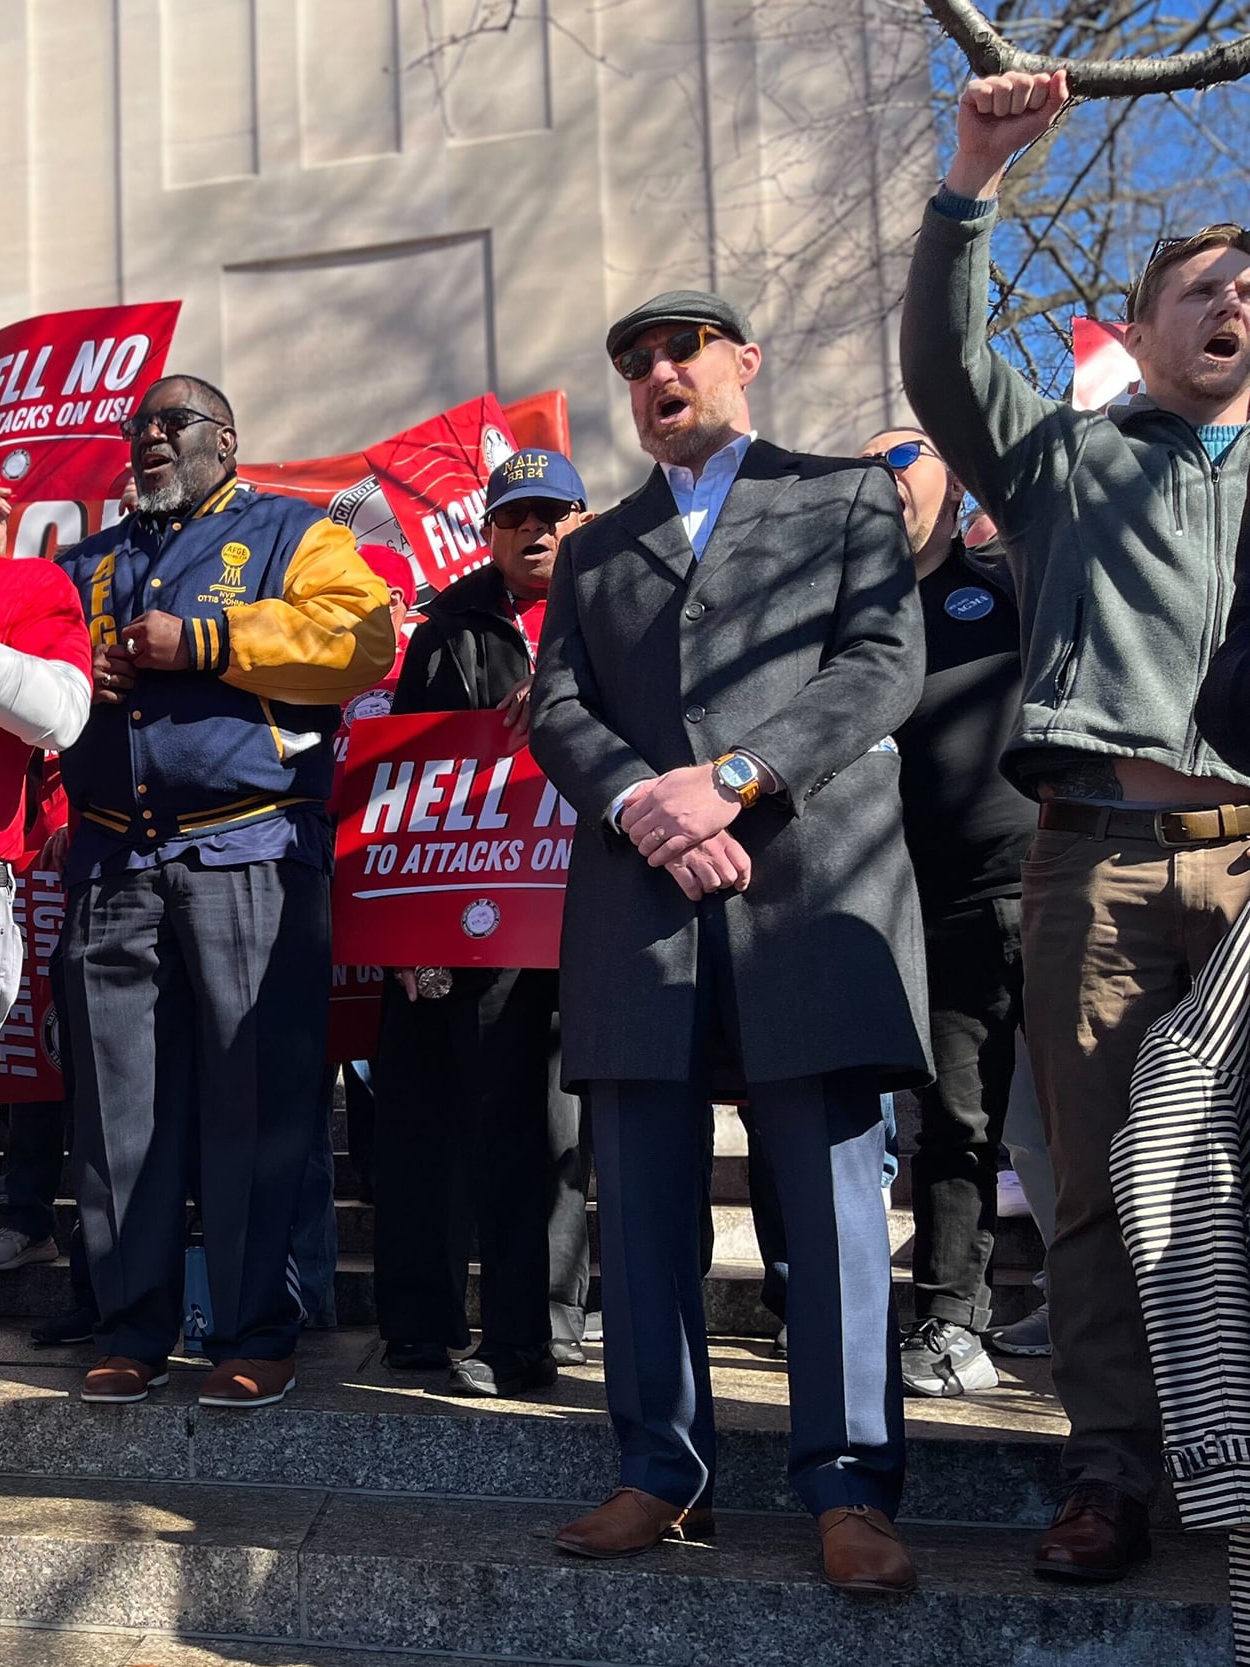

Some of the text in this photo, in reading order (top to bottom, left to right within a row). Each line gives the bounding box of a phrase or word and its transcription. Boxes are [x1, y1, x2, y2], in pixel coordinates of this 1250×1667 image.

[61, 334, 151, 397] NO
[56, 402, 91, 427] ON
[94, 396, 135, 423] US!
[503, 454, 549, 476] NALC
[527, 468, 544, 478] 24
[422, 485, 488, 570] FIGH
[361, 757, 513, 834] HELL
[364, 844, 398, 875] TO
[401, 840, 524, 875] ATTACKS
